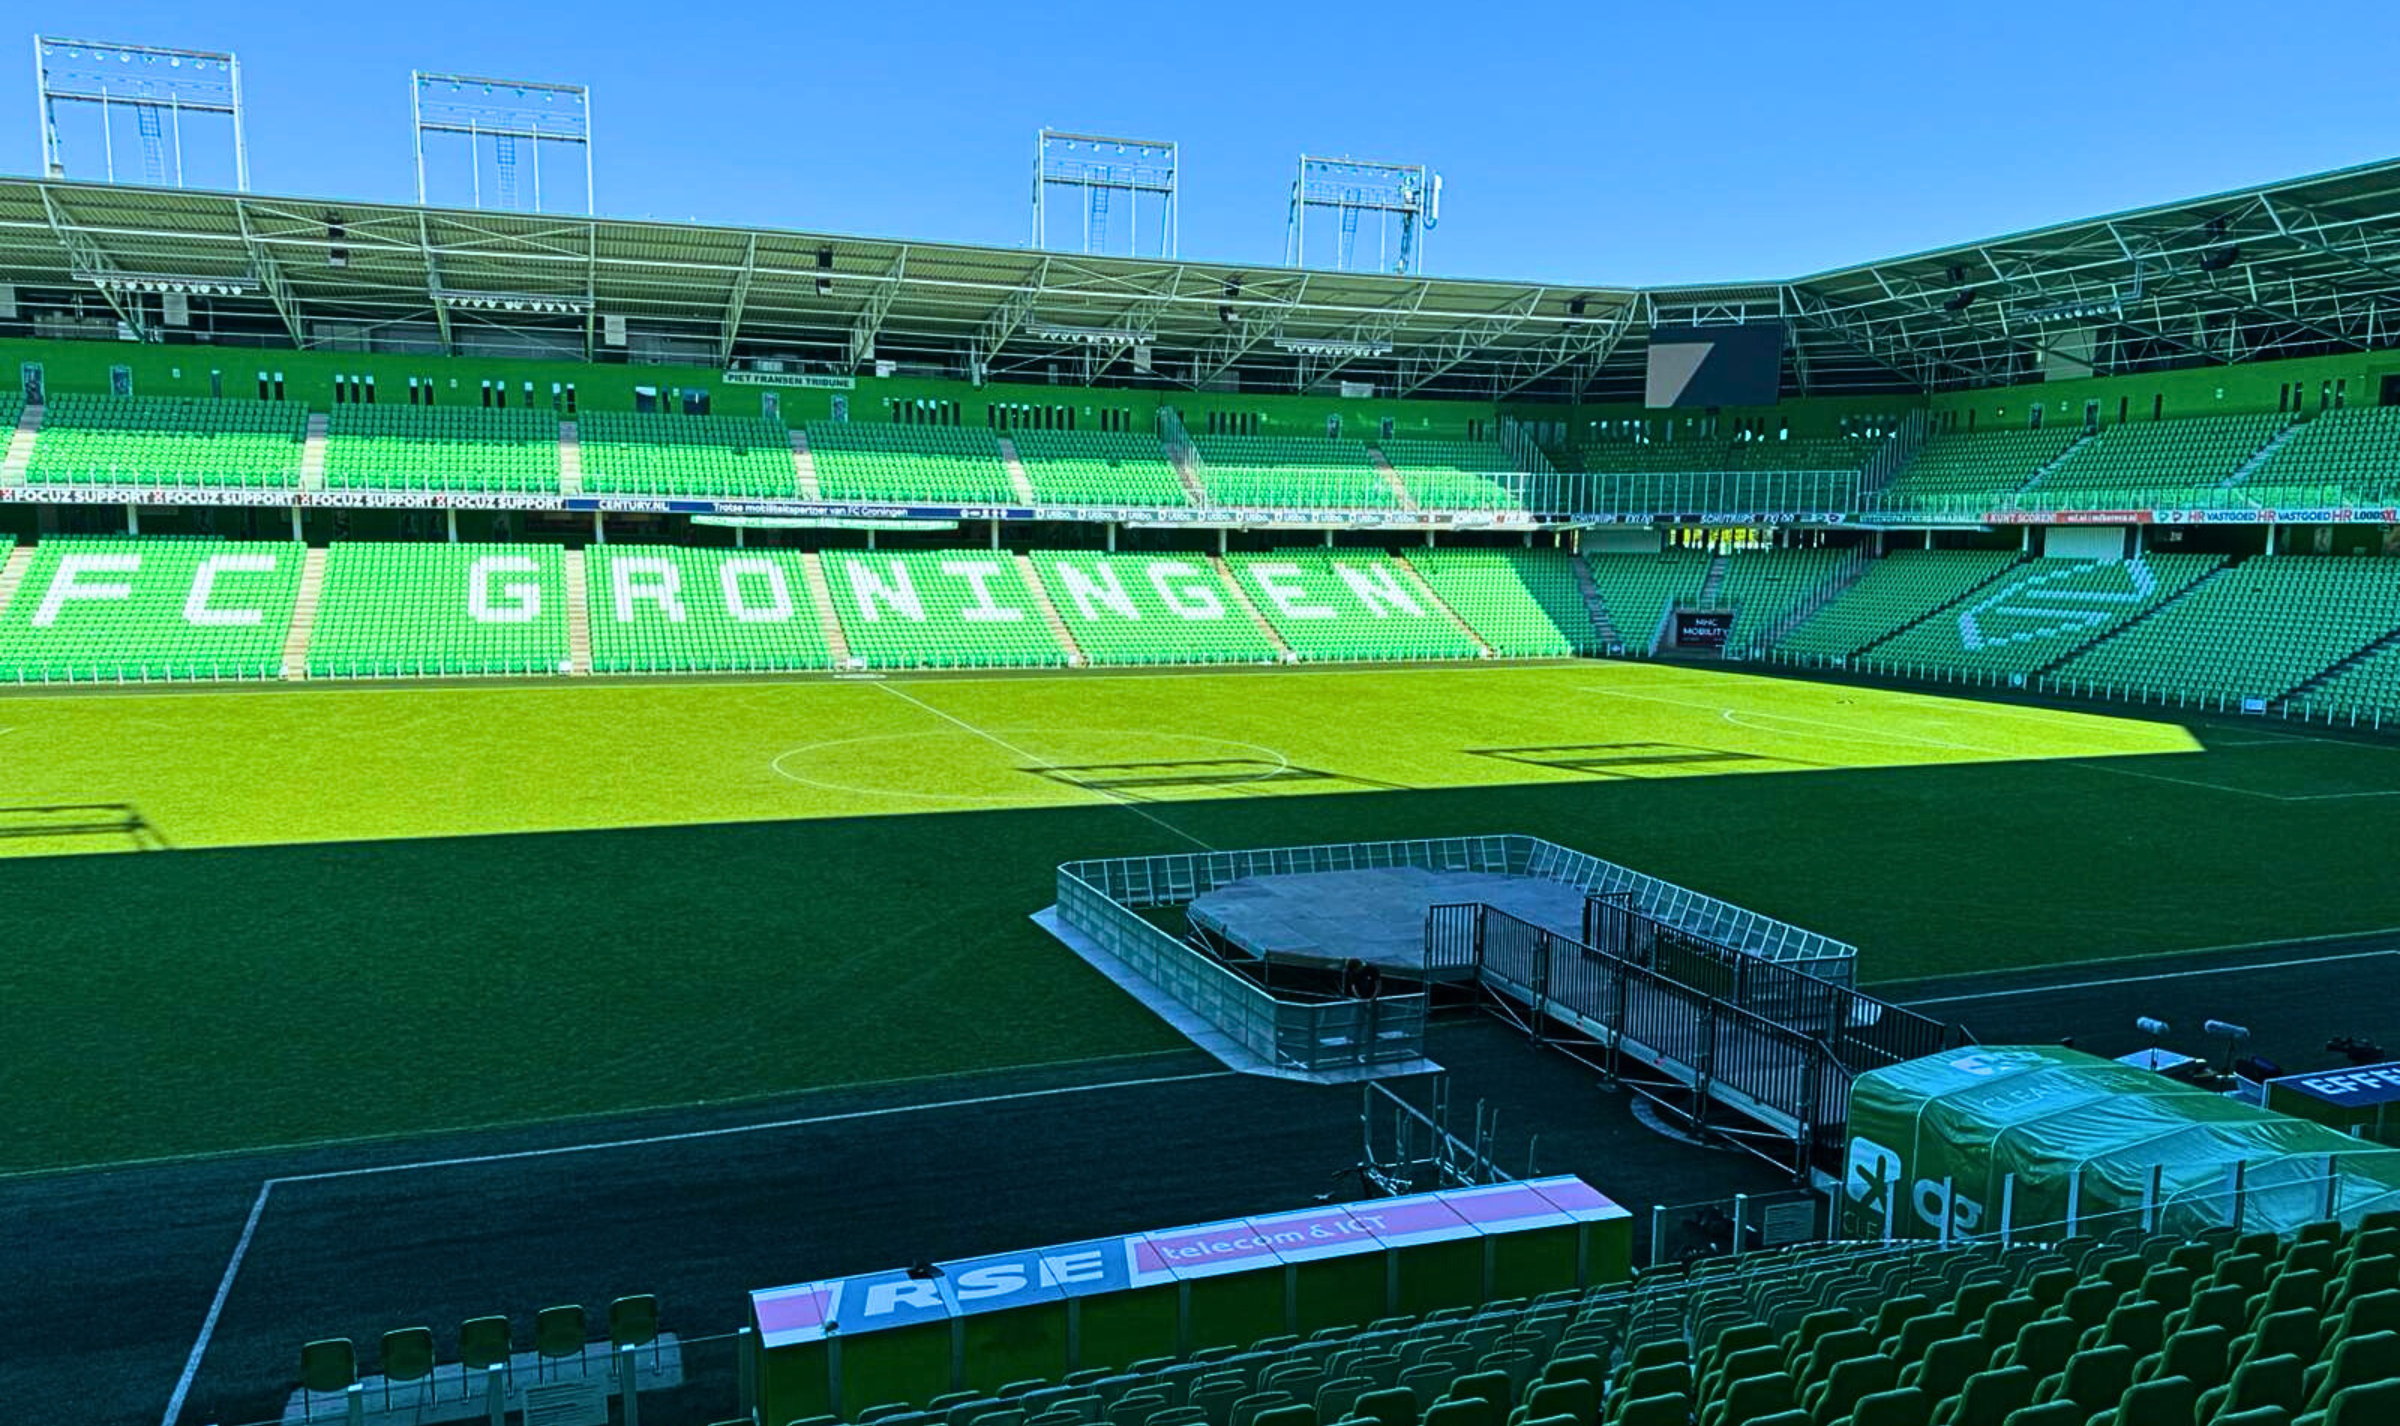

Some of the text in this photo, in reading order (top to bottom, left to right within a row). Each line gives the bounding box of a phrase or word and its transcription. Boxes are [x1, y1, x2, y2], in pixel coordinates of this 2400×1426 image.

[728, 375, 850, 388] PIET FRANSEN TRIBUNE
[15, 490, 150, 503] FOCUZ SUPPORT
[165, 491, 295, 505] FOCUZ SUPPORT
[311, 495, 433, 508] FOCUZ SUPPORT
[447, 496, 564, 510] FOCUZ SUPPORT
[599, 500, 670, 511] CENTURY.NL
[862, 507, 908, 519] Groningen
[2188, 510, 2256, 522] HR VASTGOED
[2257, 510, 2331, 522] HR VASTGOED
[2332, 510, 2351, 522] HR
[31, 554, 1425, 628] FC GRONINGEN
[2301, 1067, 2400, 1095] EFFE
[1162, 1214, 1387, 1260] telecom & ICT
[863, 1250, 1104, 1317] RSE
